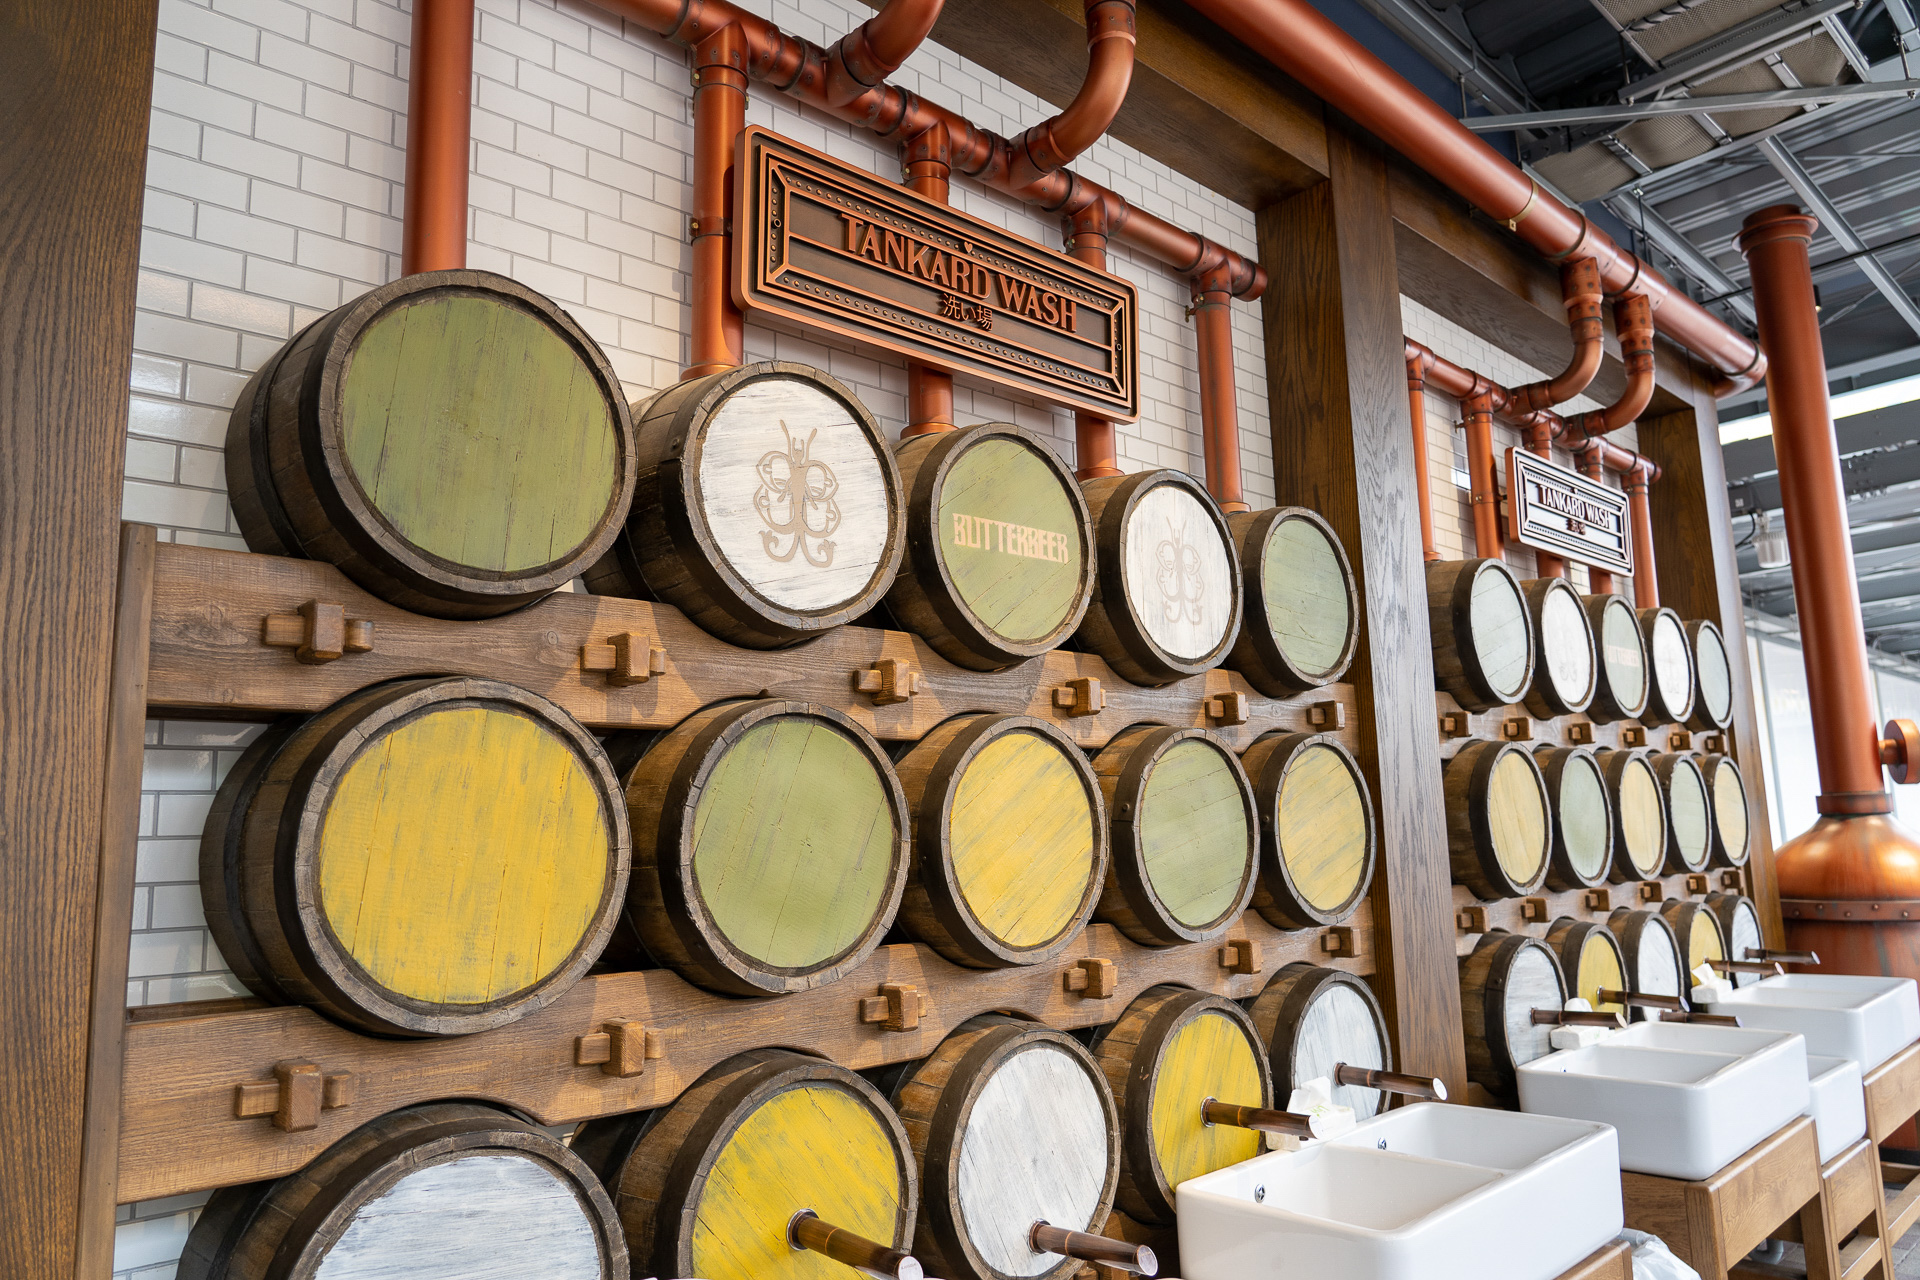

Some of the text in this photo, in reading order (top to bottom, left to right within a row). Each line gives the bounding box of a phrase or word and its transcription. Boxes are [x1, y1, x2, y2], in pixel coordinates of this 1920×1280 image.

[839, 212, 1078, 333] TANKARD WASH
[942, 292, 993, 331] 洗い場
[1540, 484, 1585, 520] TANKARD
[1585, 502, 1611, 530] WASH
[952, 513, 1069, 564] BUTTERBEER
